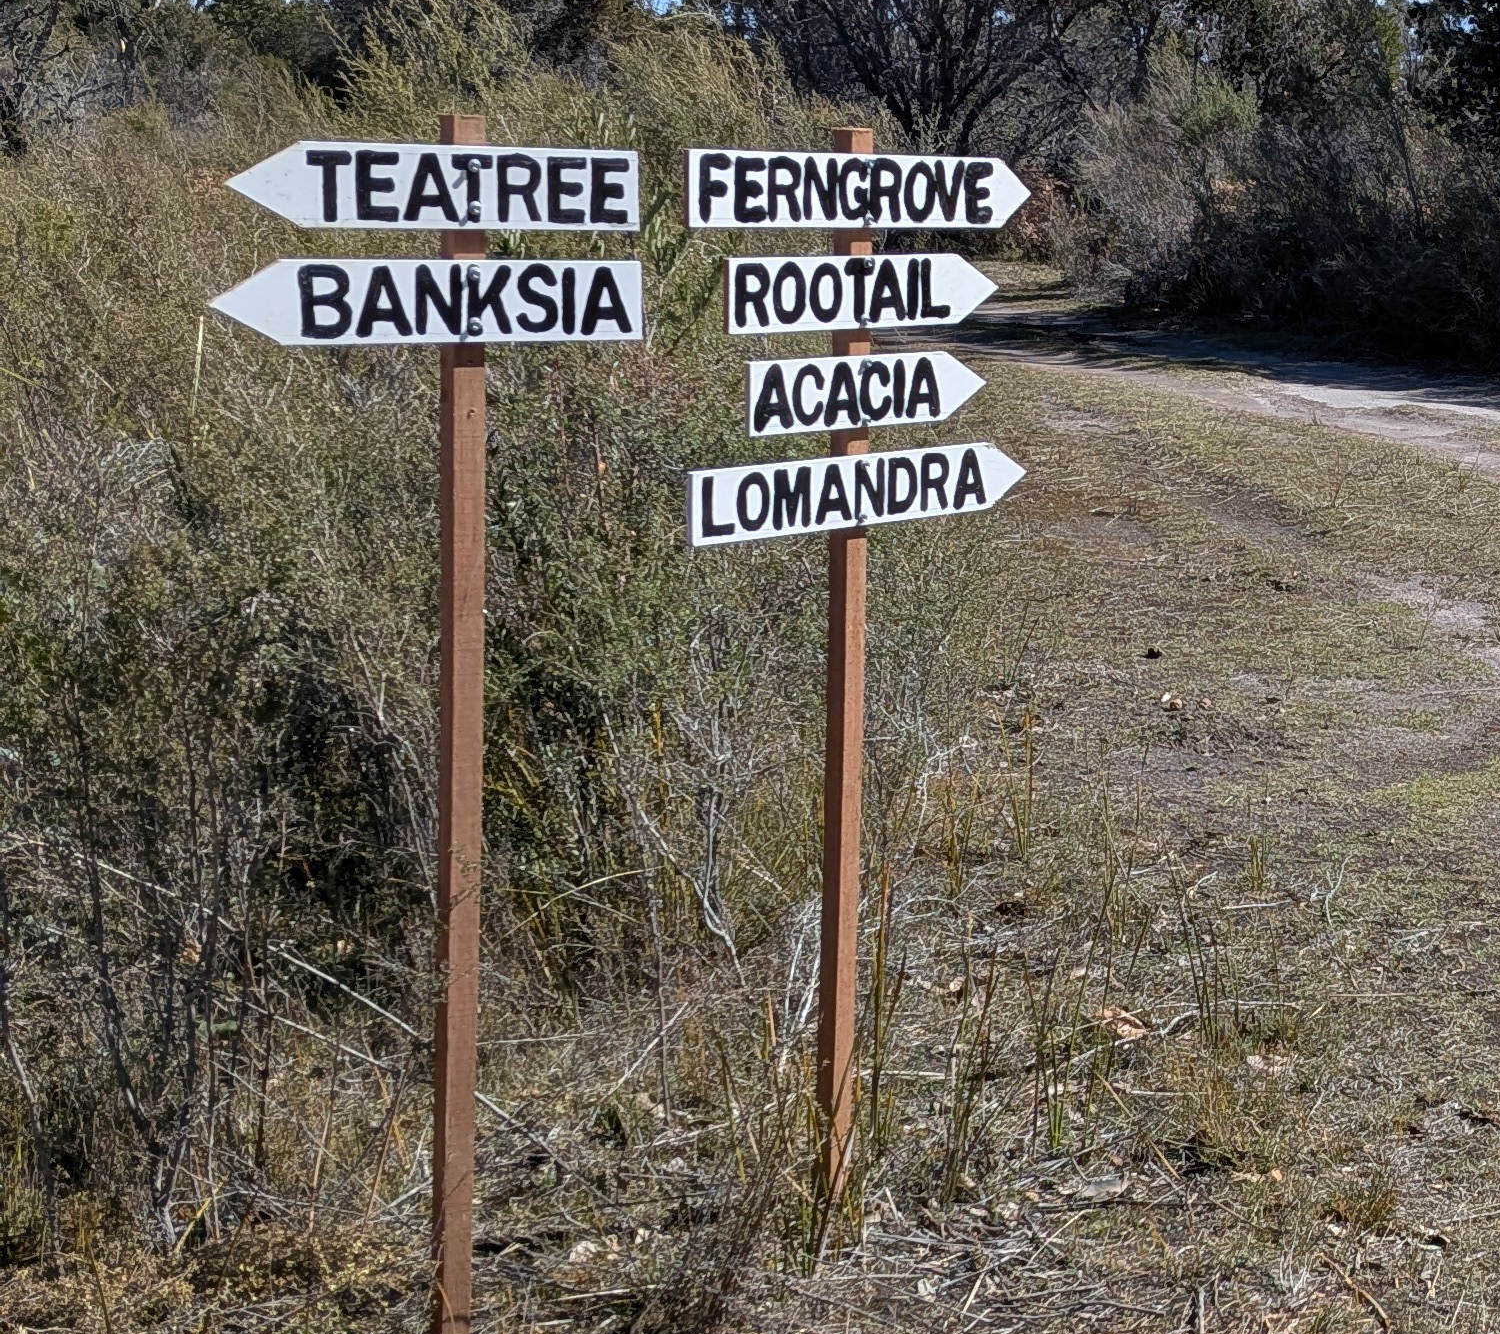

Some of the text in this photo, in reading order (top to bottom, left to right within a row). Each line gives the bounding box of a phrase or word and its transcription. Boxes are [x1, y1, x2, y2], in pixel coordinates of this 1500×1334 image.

[306, 150, 629, 223] TEATREE
[699, 153, 993, 224] FERNGROVE
[298, 263, 632, 338] BANKSIA
[735, 257, 951, 327] ROOTAIL
[754, 357, 941, 432] ACACIA
[702, 448, 986, 537] LOMANDRA
